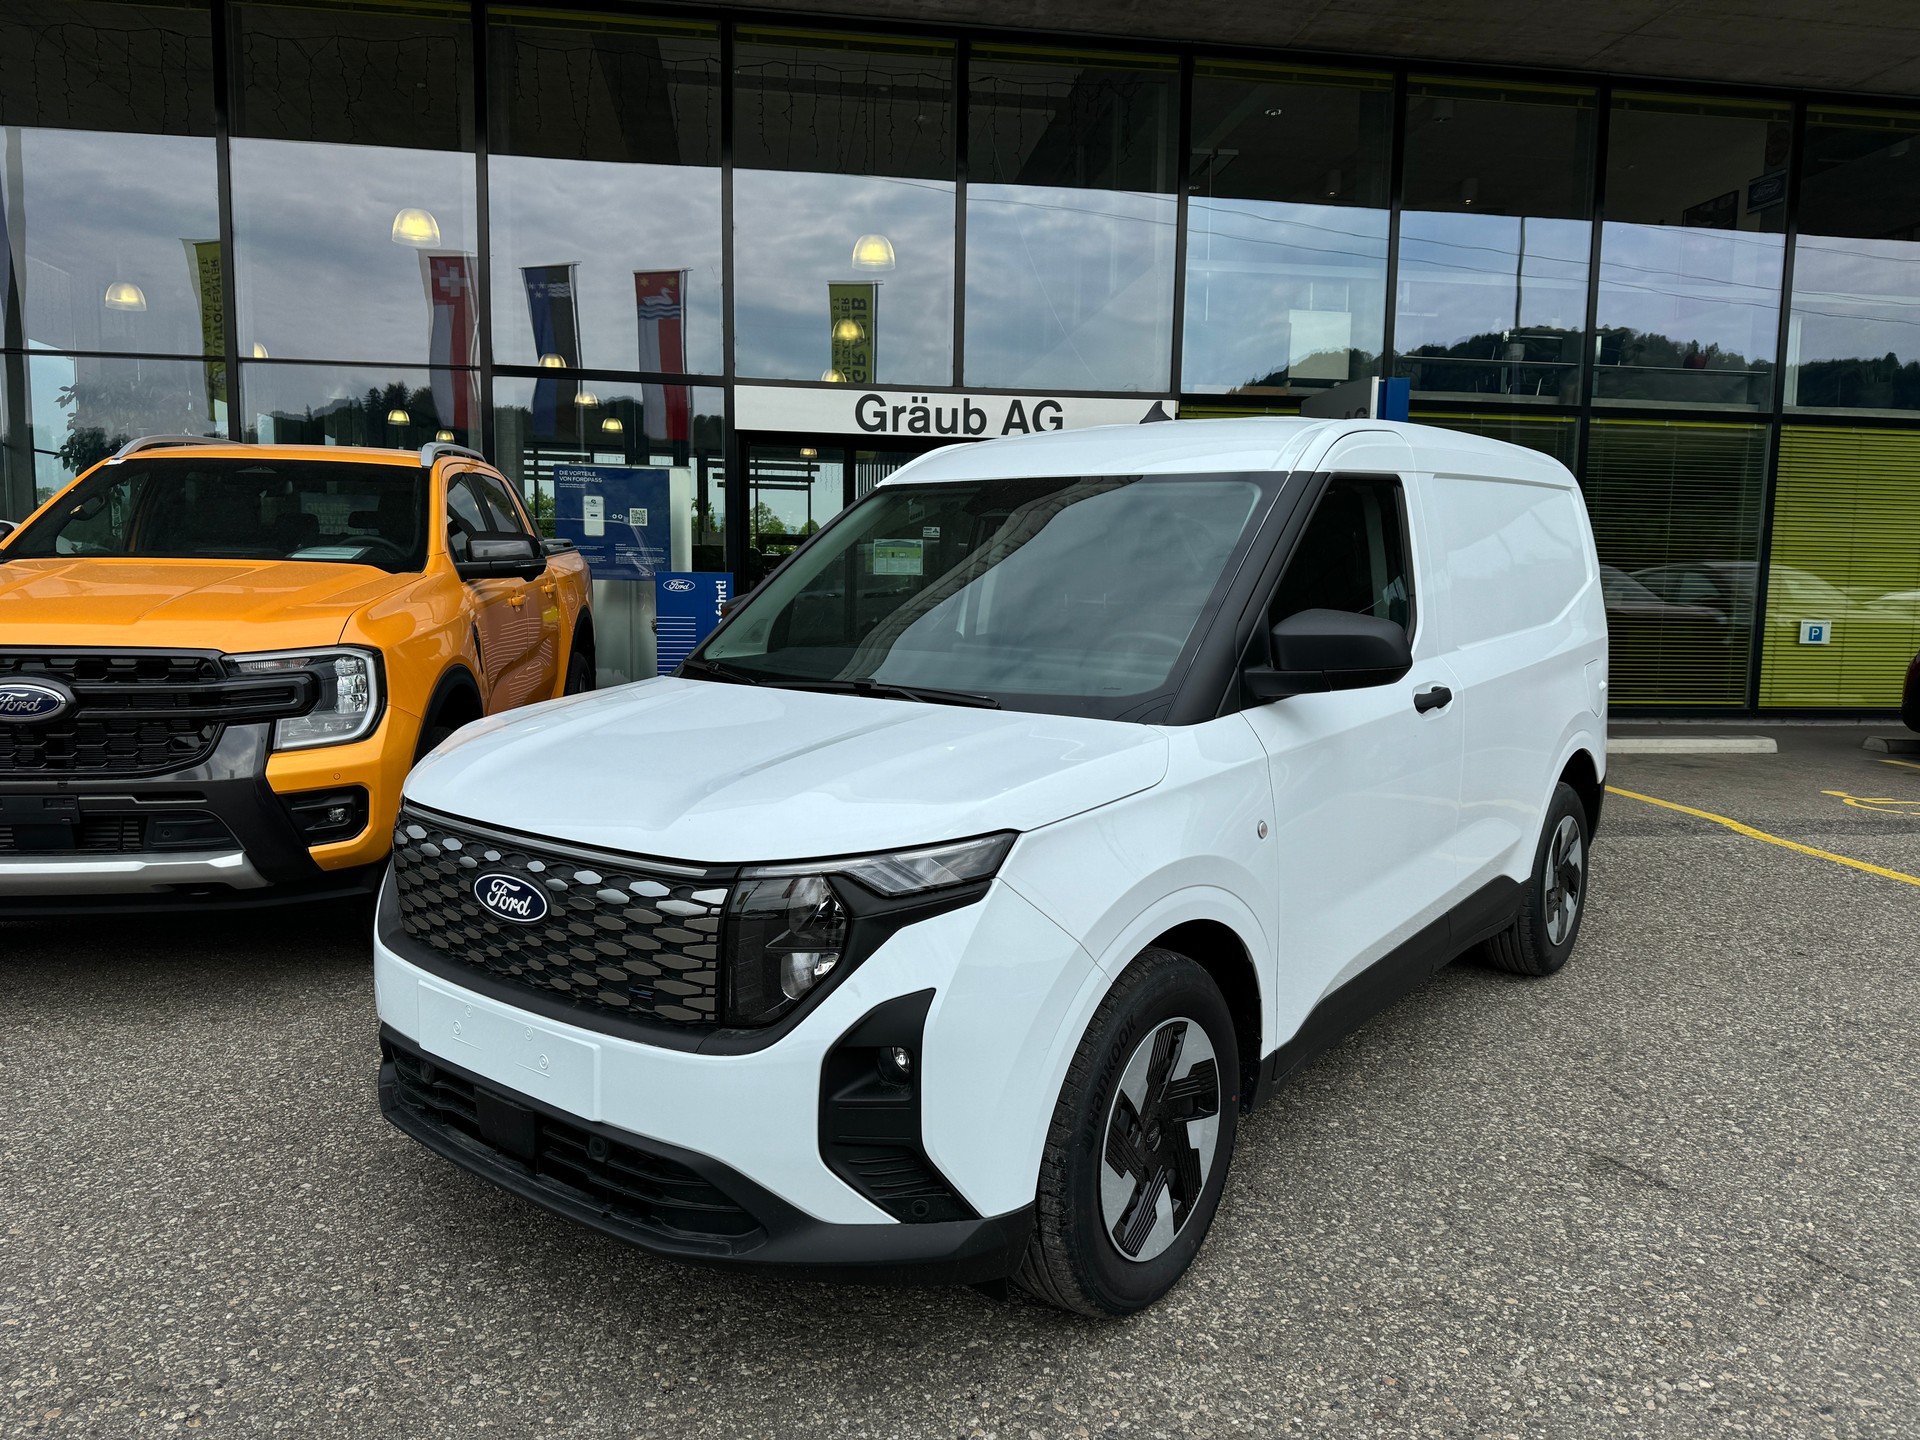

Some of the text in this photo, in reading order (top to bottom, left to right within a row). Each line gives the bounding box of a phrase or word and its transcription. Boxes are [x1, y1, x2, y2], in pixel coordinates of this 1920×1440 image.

[854, 393, 1064, 436] Gräub AG
[667, 579, 691, 591] Ford
[0, 691, 43, 712] Ford
[485, 878, 534, 917] Ford
